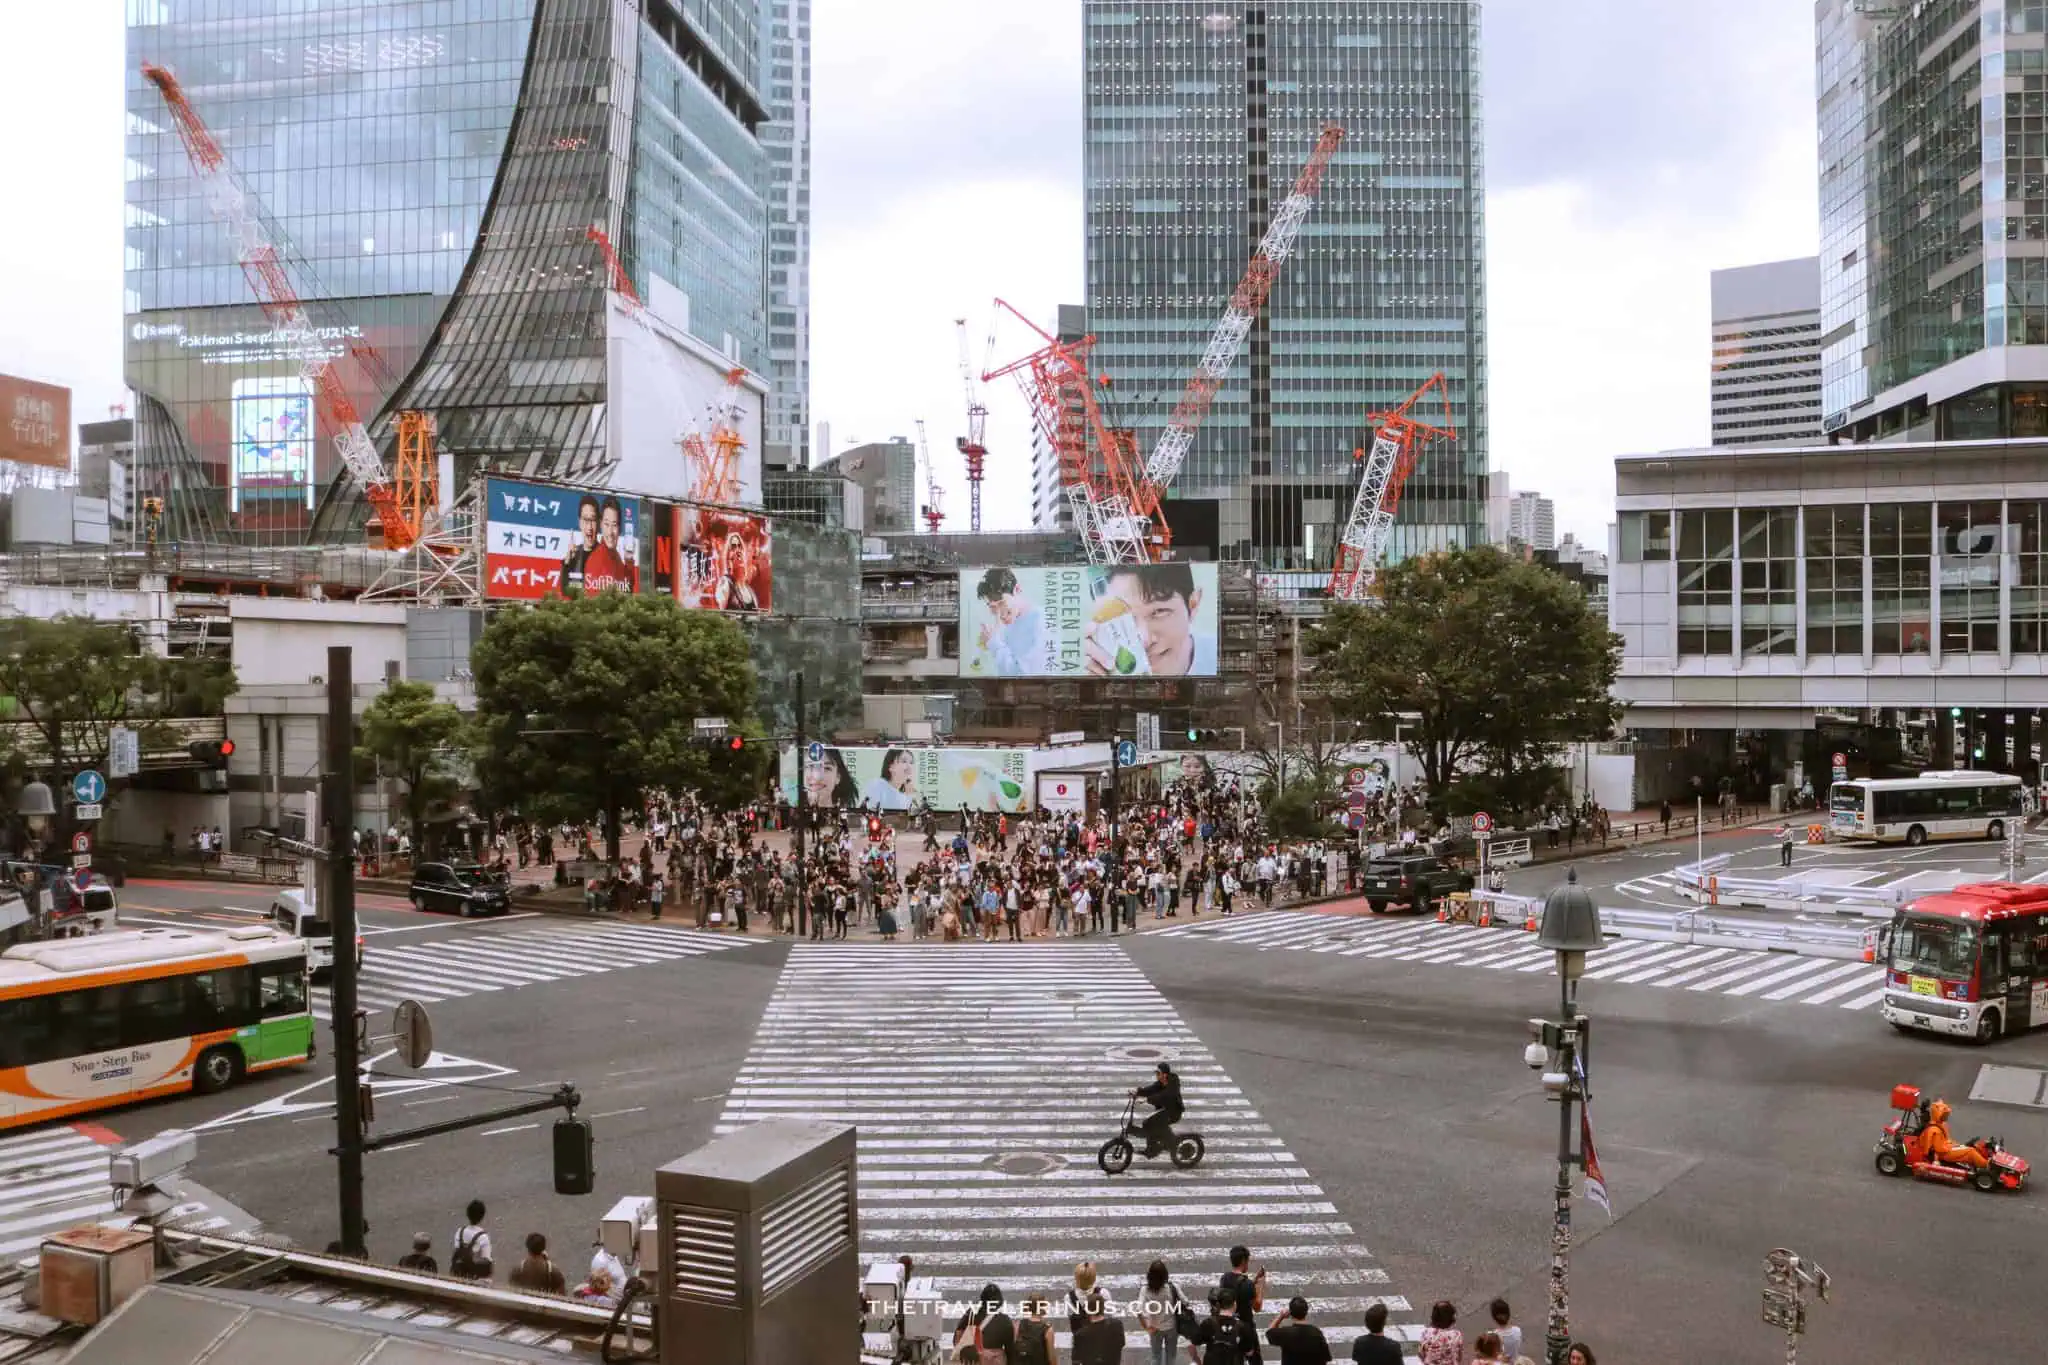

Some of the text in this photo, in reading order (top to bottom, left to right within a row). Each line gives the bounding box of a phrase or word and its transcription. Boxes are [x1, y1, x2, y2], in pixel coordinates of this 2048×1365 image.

[517, 495, 561, 517] オトク
[503, 531, 561, 552] オドロク
[492, 567, 561, 588] ペイトク
[585, 573, 631, 593] SoftBank
[1044, 571, 1057, 630] NAMACHA
[1061, 571, 1081, 672] GREEN TEA
[928, 752, 939, 785] GREEN
[131, 1050, 151, 1063] Bus
